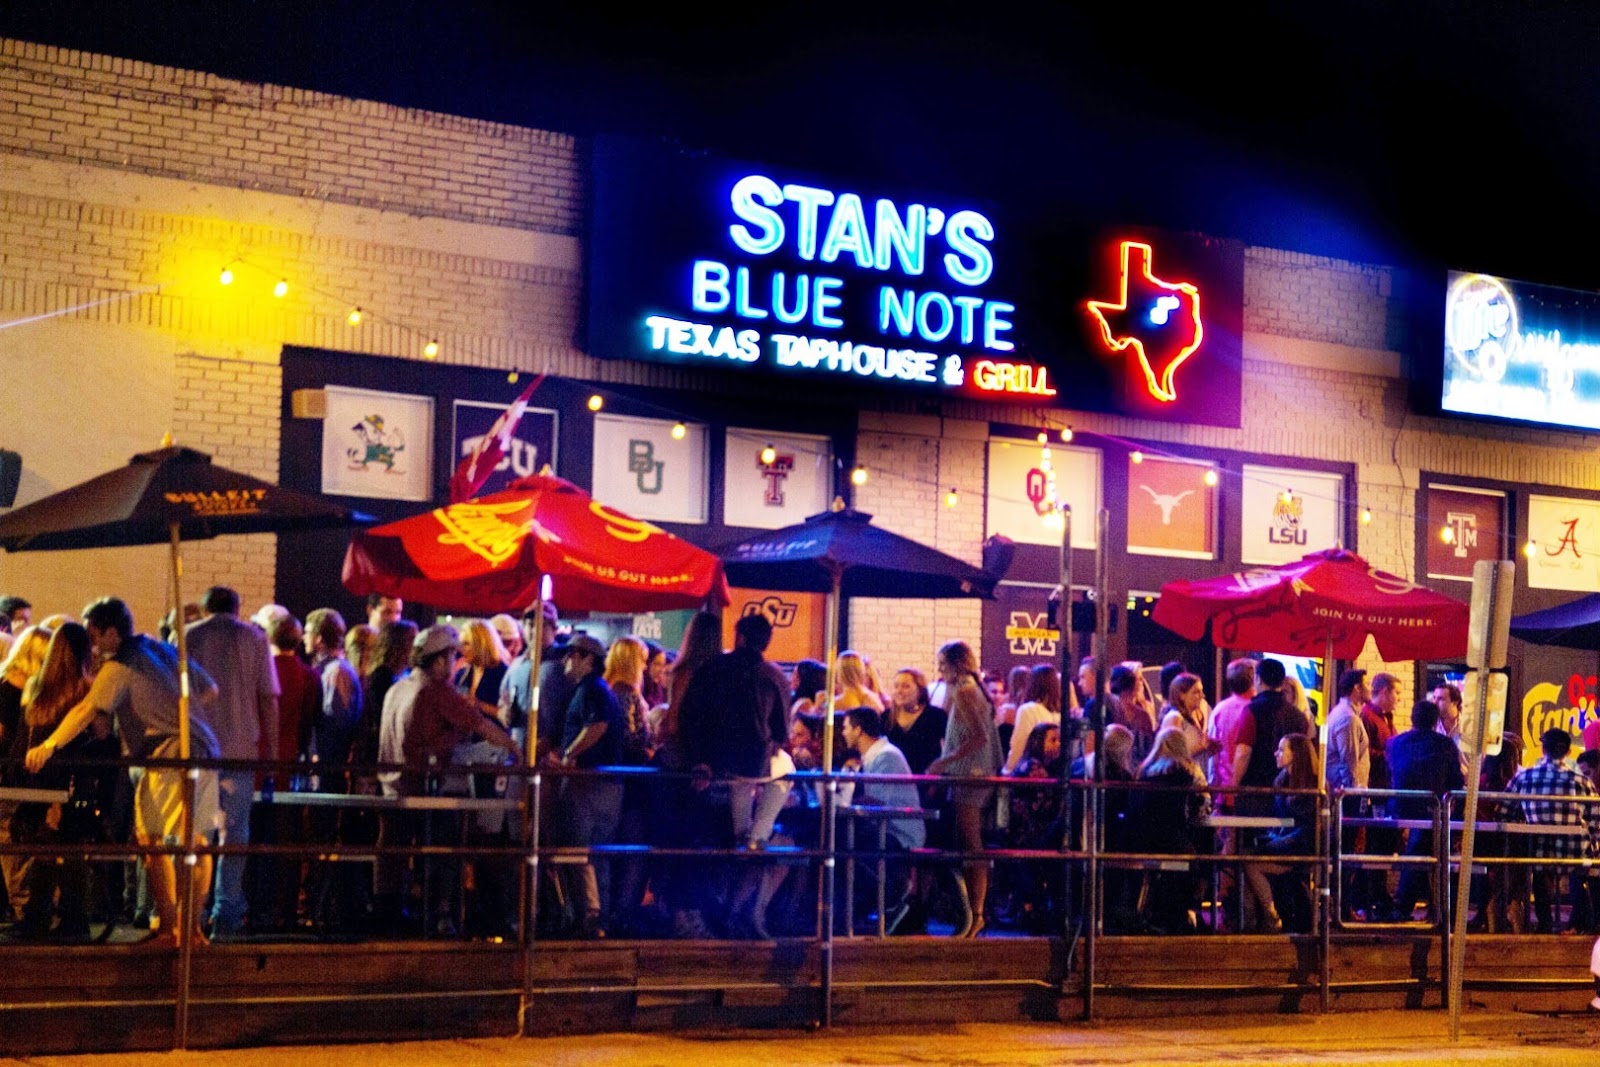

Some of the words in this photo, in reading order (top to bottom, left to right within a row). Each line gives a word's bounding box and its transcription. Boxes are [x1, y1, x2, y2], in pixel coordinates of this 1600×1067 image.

[730, 174, 995, 286] STAN'S
[692, 260, 844, 328] BLUE
[879, 286, 1016, 351] NOTE
[646, 316, 760, 362] TEXAS
[771, 334, 938, 382] TAPHOUSE
[943, 354, 964, 385] &
[974, 361, 1056, 396] GRILL
[1268, 526, 1308, 546] LSU
[618, 569, 647, 584] OUT
[1312, 607, 1343, 620] JOIN
[1347, 612, 1363, 622] US
[1367, 615, 1393, 625] OUT
[1398, 617, 1437, 627] HERE.
